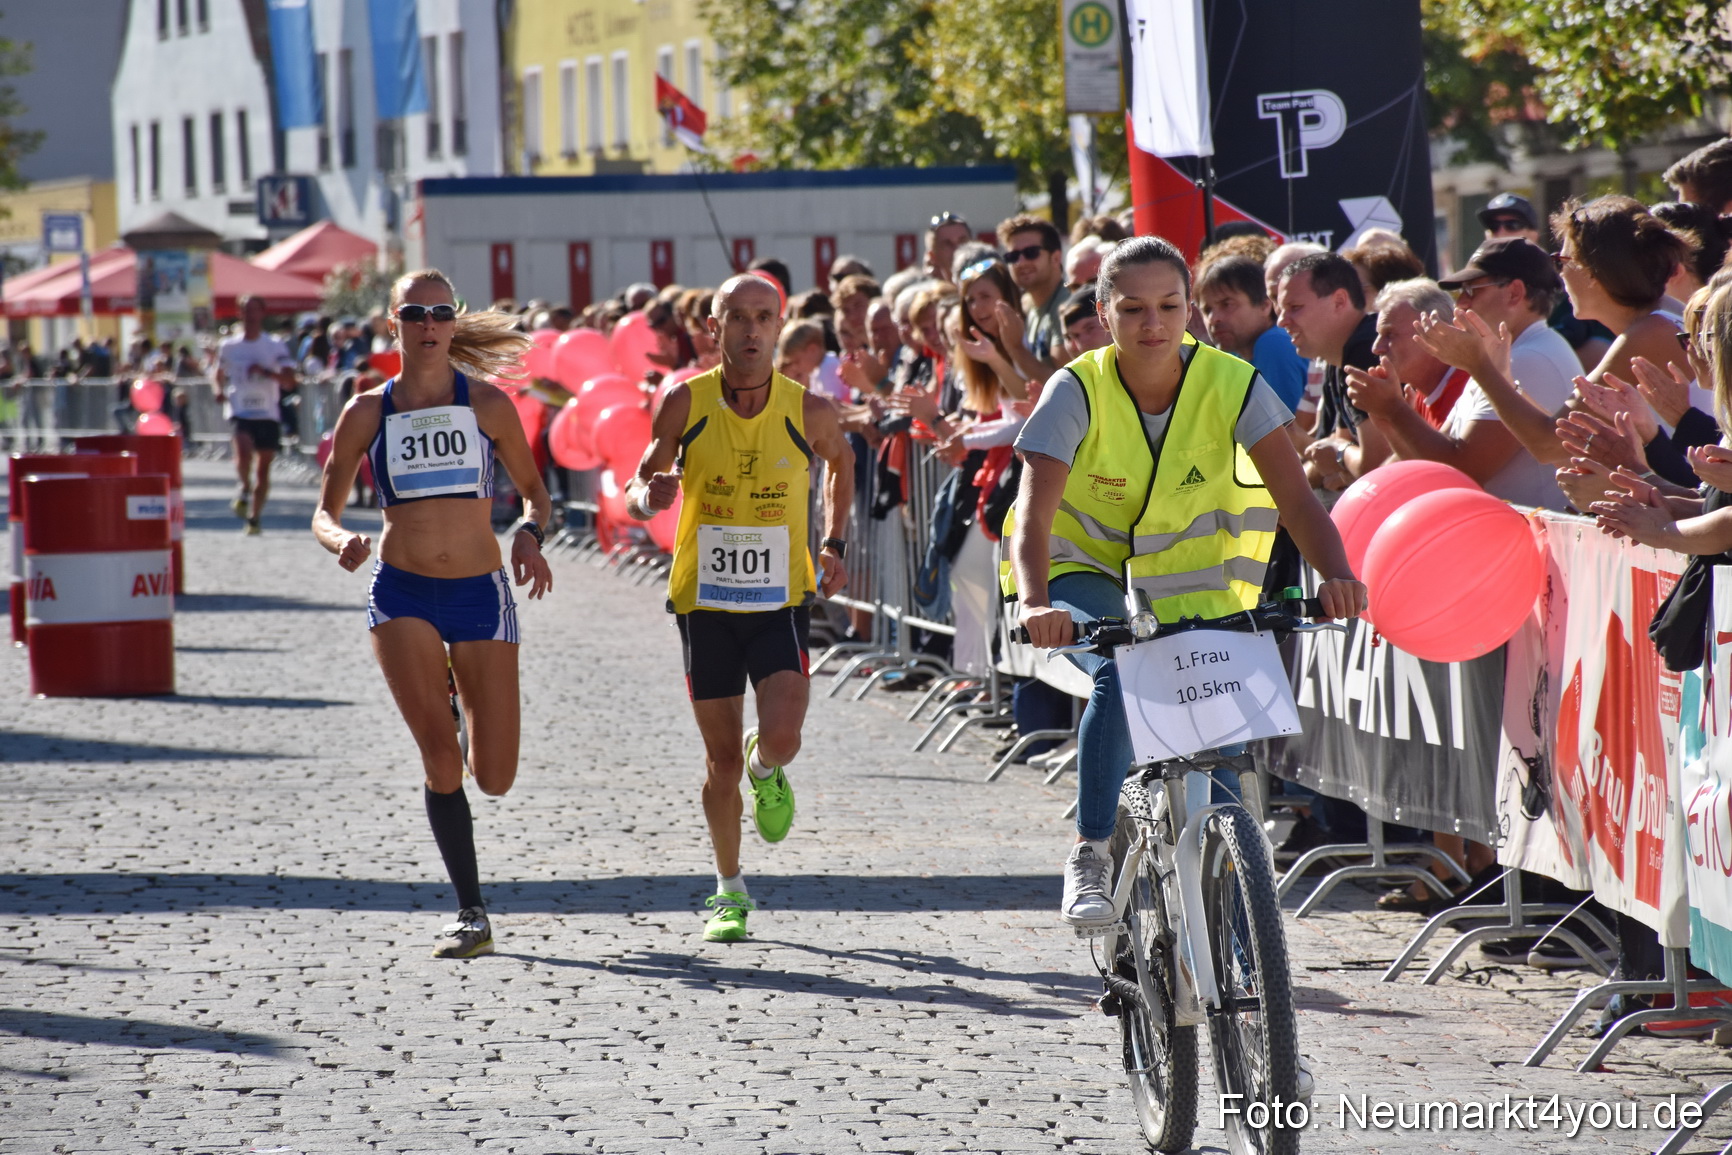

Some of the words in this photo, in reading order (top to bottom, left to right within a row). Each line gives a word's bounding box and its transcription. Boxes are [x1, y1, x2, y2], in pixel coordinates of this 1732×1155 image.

[1264, 101, 1291, 111] Team
[411, 414, 452, 429] BOCK
[401, 429, 467, 462] 3100
[428, 460, 456, 468] Neumarkt
[1087, 474, 1127, 483] NEUMARKTER
[1094, 479, 1126, 488] STADTLAUF
[702, 502, 711, 513] M
[714, 505, 724, 516] &
[726, 507, 734, 517] S
[760, 509, 784, 518] ELIO
[723, 533, 762, 542] BOCK
[711, 547, 770, 575] 3101
[716, 576, 733, 584] PARTL
[735, 577, 762, 585] Neumarkt
[710, 585, 762, 604] Jürgen
[1174, 650, 1230, 671] 1.Frau
[1176, 680, 1241, 705] 10.5km
[1589, 728, 1625, 835] Brau
